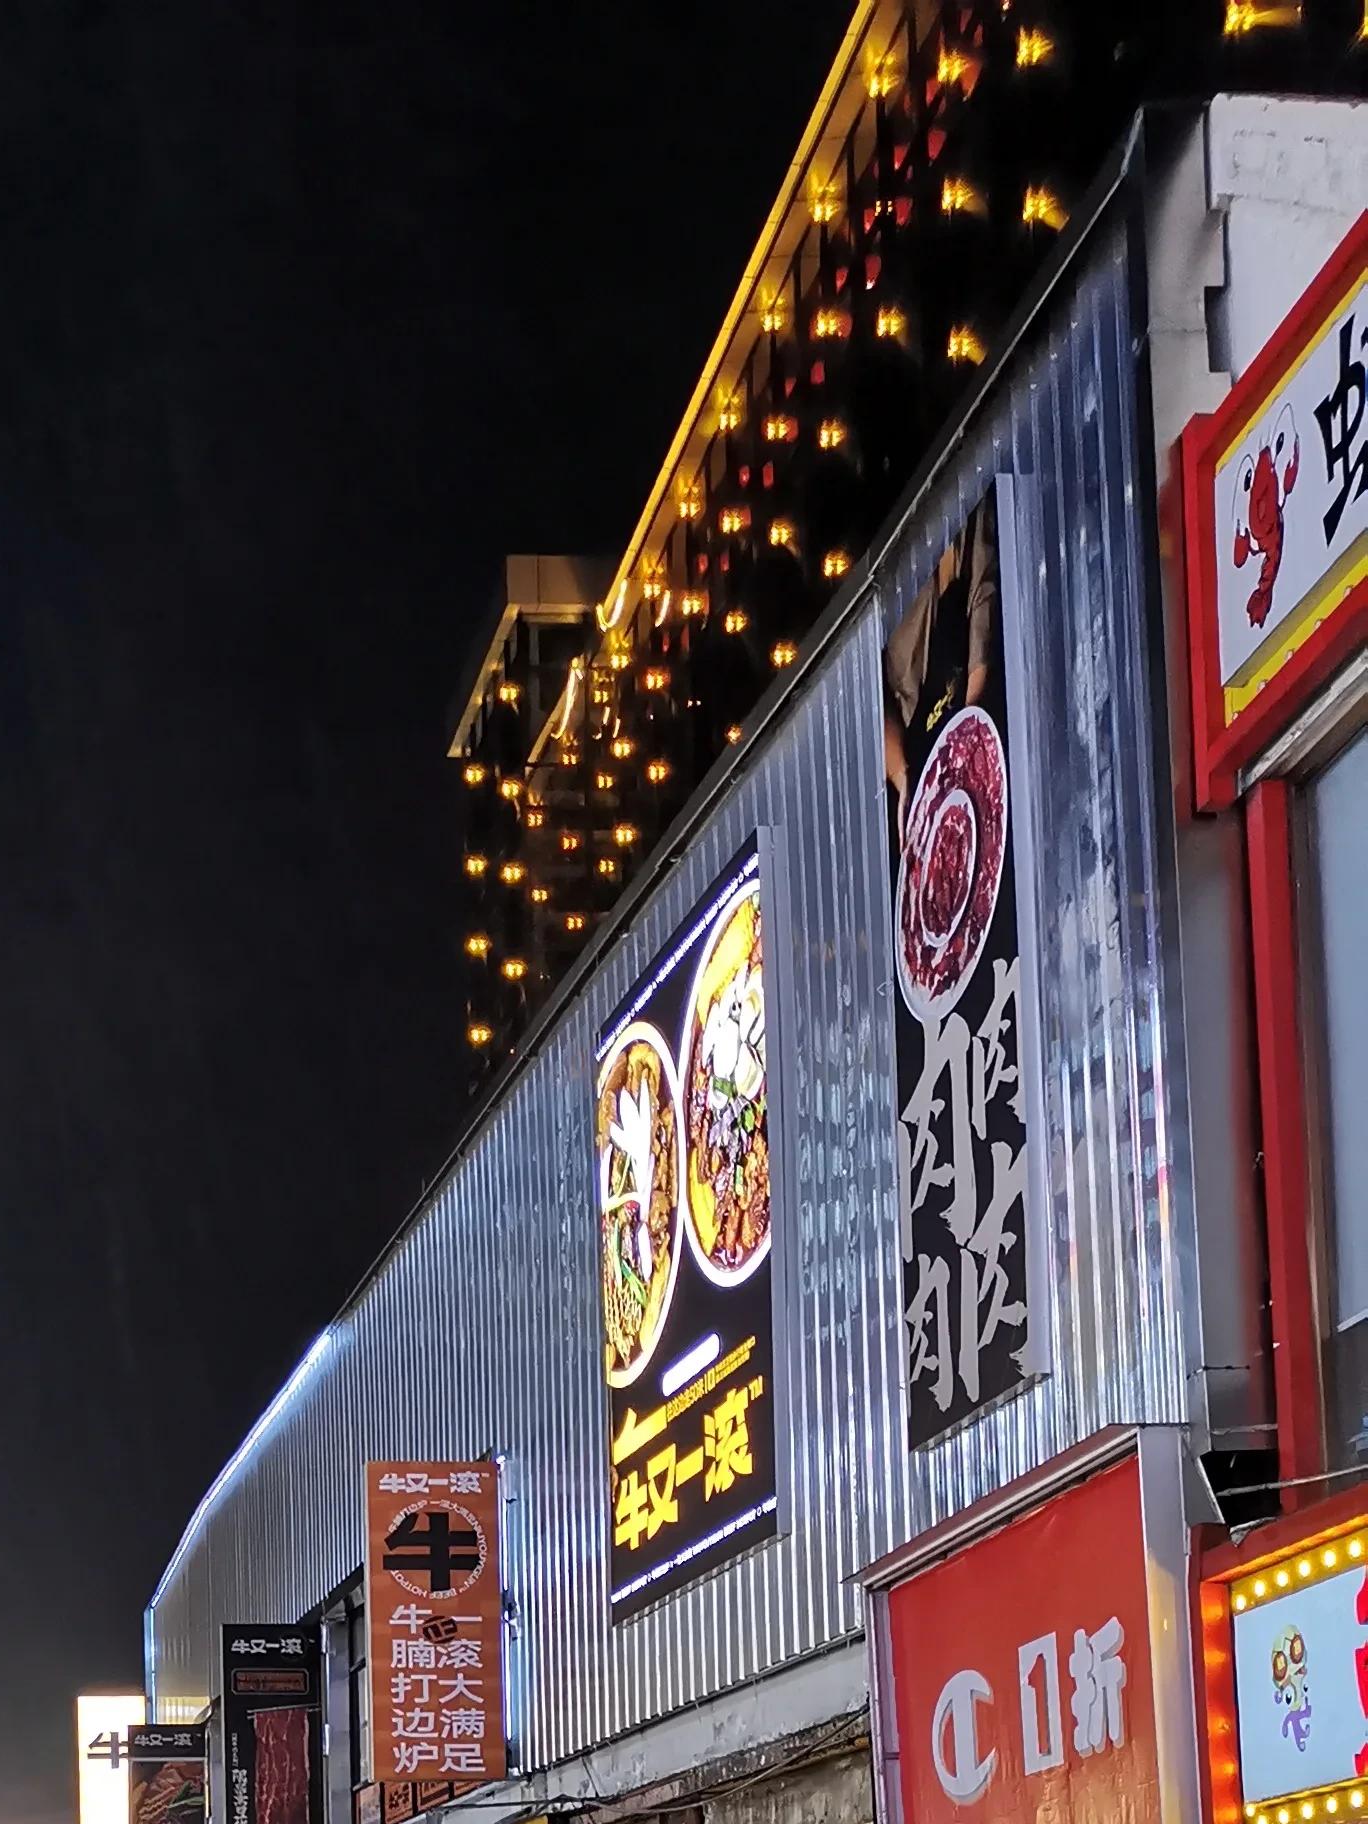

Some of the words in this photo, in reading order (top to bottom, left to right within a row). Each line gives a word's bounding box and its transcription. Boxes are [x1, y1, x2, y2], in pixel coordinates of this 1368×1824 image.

[378, 1471, 482, 1494] 牛又一滚
[231, 1638, 304, 1655] 牛又一滚
[389, 1603, 439, 1774] 牛腩打边炉
[436, 1614, 486, 1773] 一滚大满足
[134, 1733, 193, 1747] 牛又一滚
